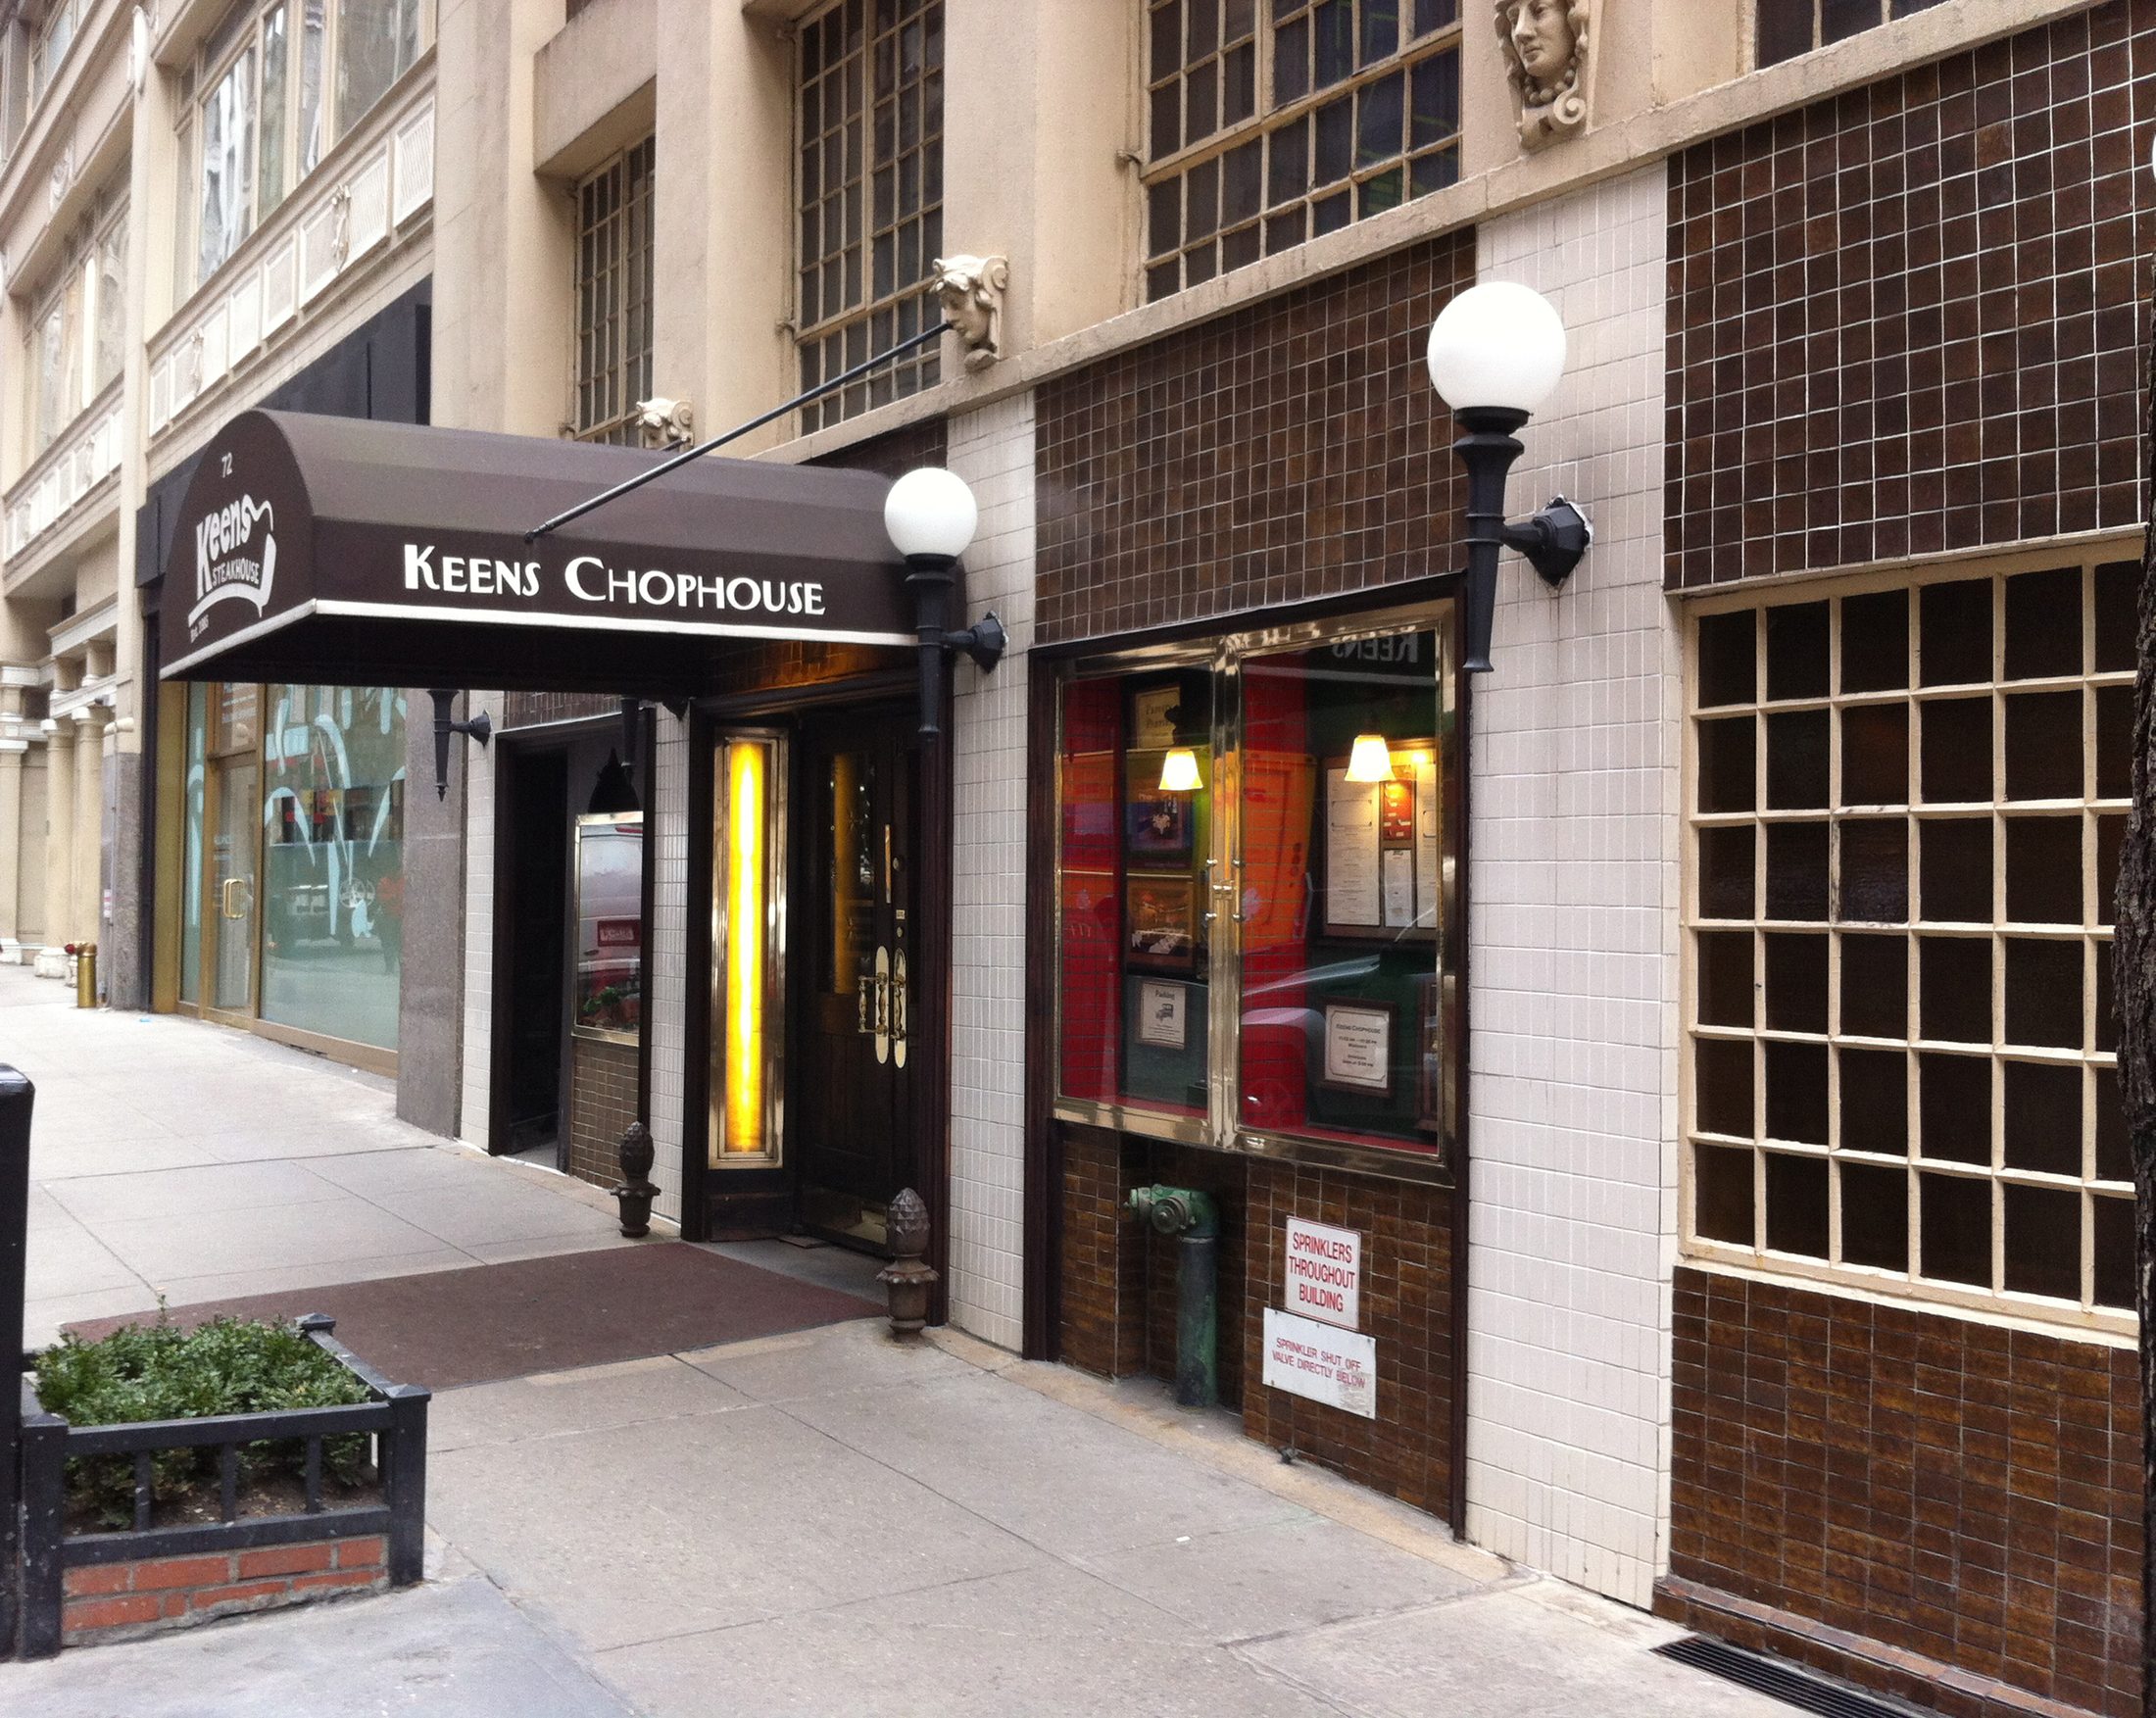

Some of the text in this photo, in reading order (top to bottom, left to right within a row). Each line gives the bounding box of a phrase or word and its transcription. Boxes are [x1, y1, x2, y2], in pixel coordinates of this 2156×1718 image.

[221, 452, 233, 478] 72
[196, 494, 273, 601] Keens
[213, 558, 260, 587] STEAKHOUSE
[404, 544, 825, 615] KEENS CHOPHOUSE
[1293, 1232, 1352, 1263] SPRINKLERS
[1289, 1255, 1355, 1290] THROUGHOUT
[1299, 1284, 1344, 1312] BUILDING
[1272, 1350, 1365, 1389] VALVE DIRECTLY BELOW
[1276, 1337, 1361, 1372] SPRINKLER SHUT OFF
